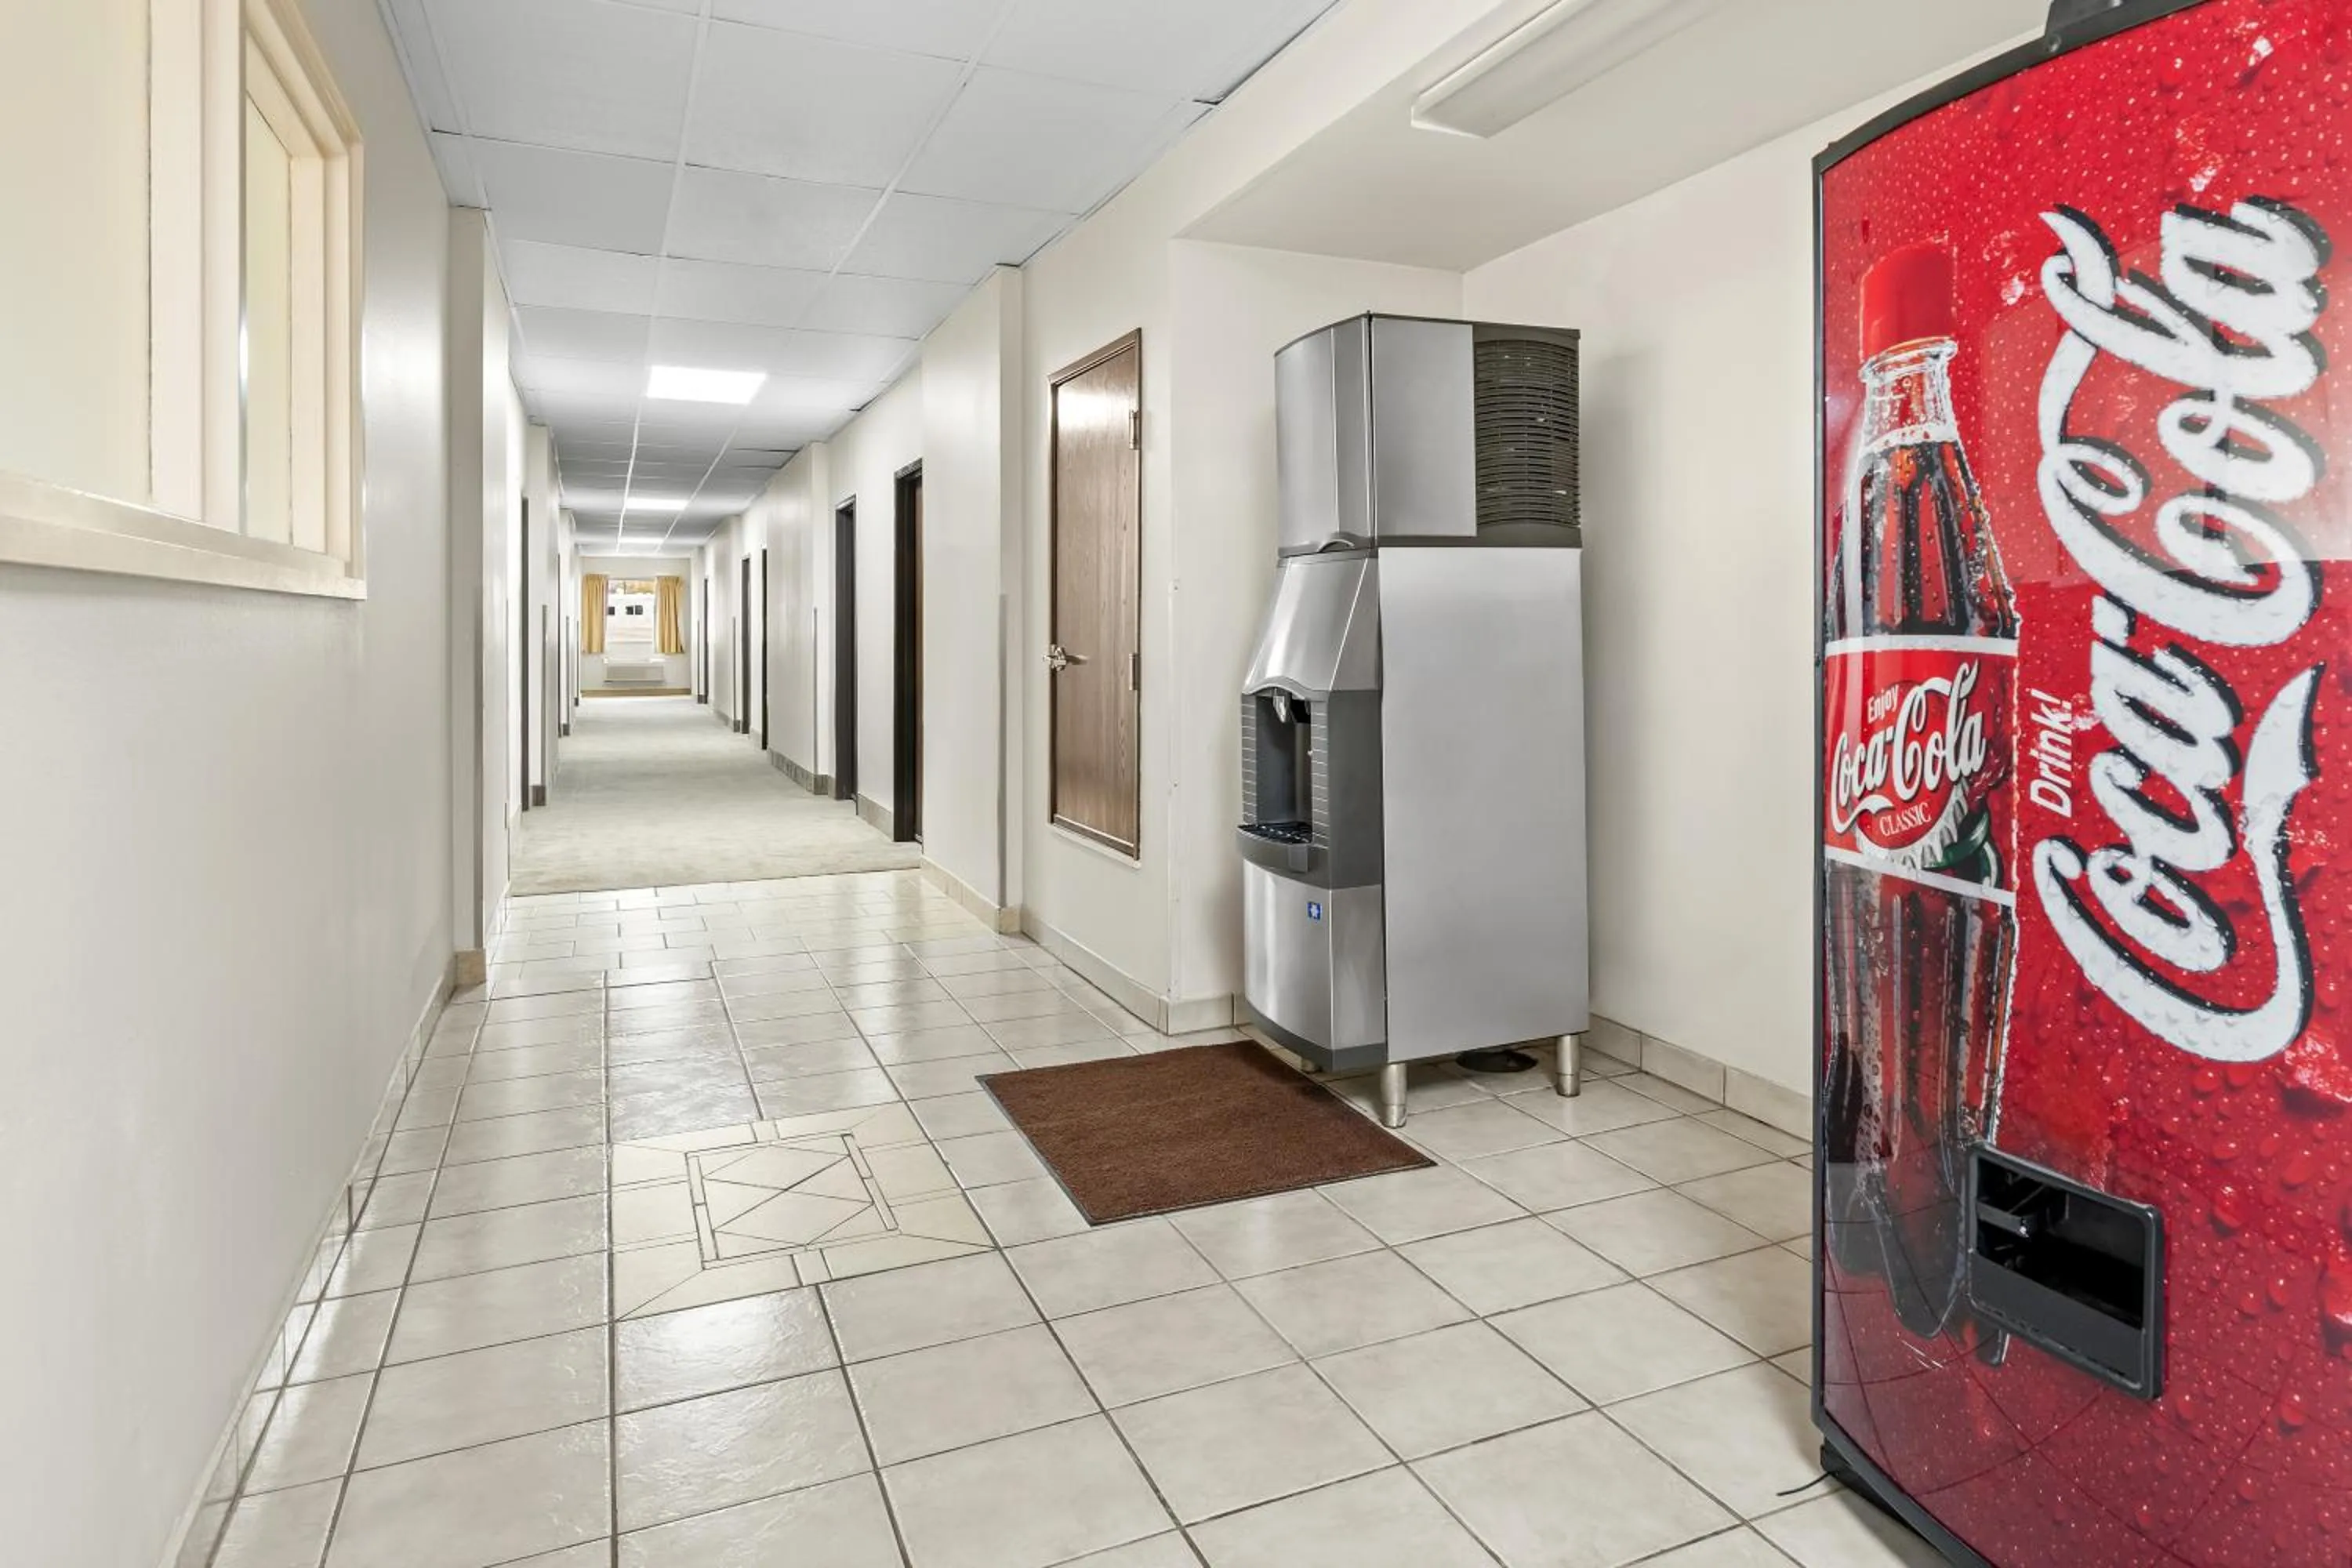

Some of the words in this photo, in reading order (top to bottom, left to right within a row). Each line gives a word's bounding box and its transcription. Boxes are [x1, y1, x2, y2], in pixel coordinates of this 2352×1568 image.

[1867, 684, 1899, 724] Enjoy
[2029, 688, 2072, 818] Drink!
[1879, 801, 1932, 837] CLASSIC
